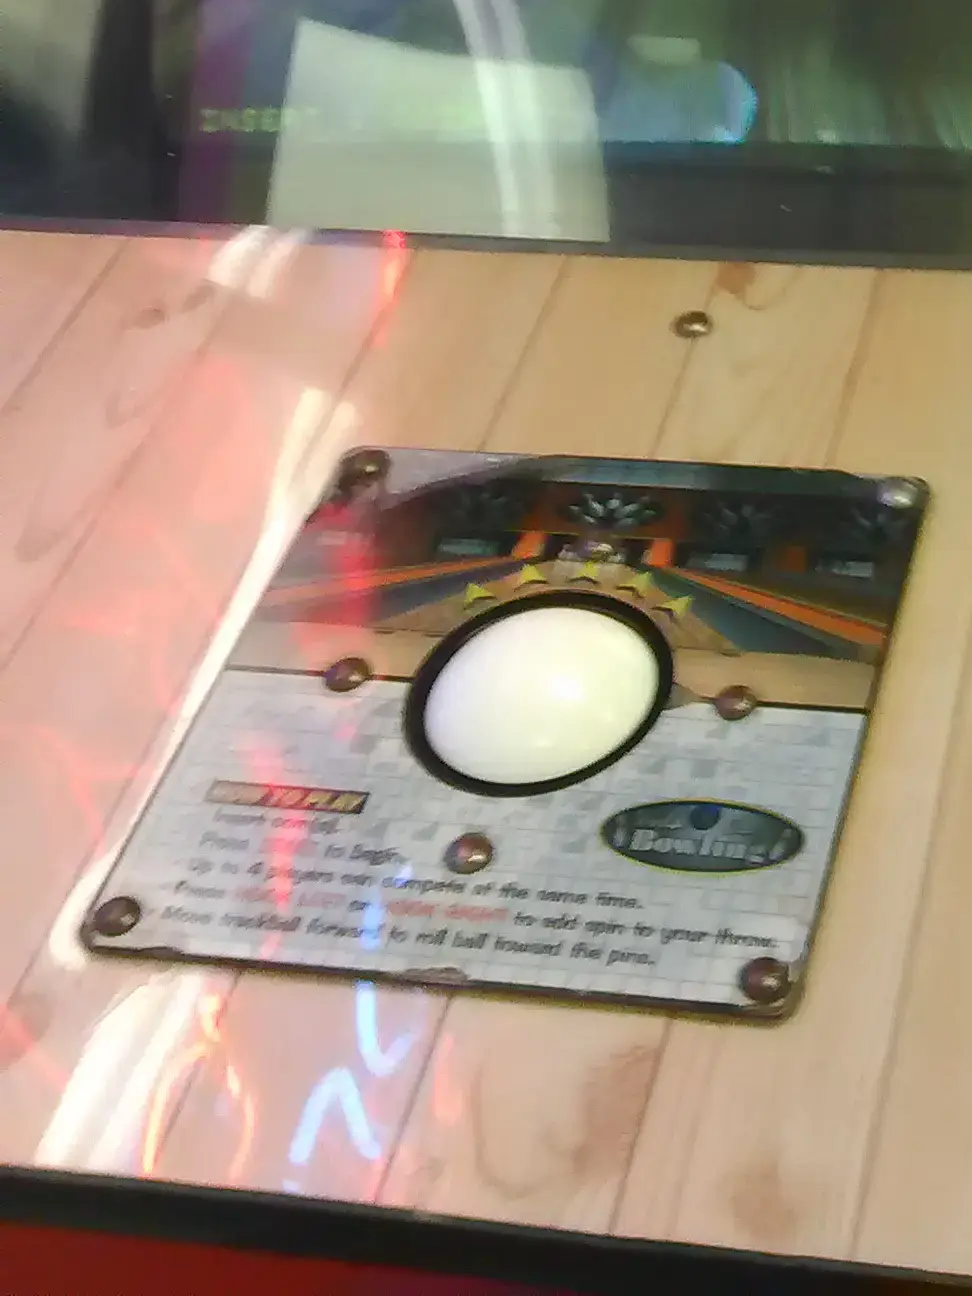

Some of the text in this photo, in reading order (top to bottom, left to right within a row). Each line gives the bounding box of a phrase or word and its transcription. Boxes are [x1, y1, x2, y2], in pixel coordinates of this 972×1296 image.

[499, 881, 530, 899] the
[536, 889, 588, 905] same
[569, 941, 602, 959] the
